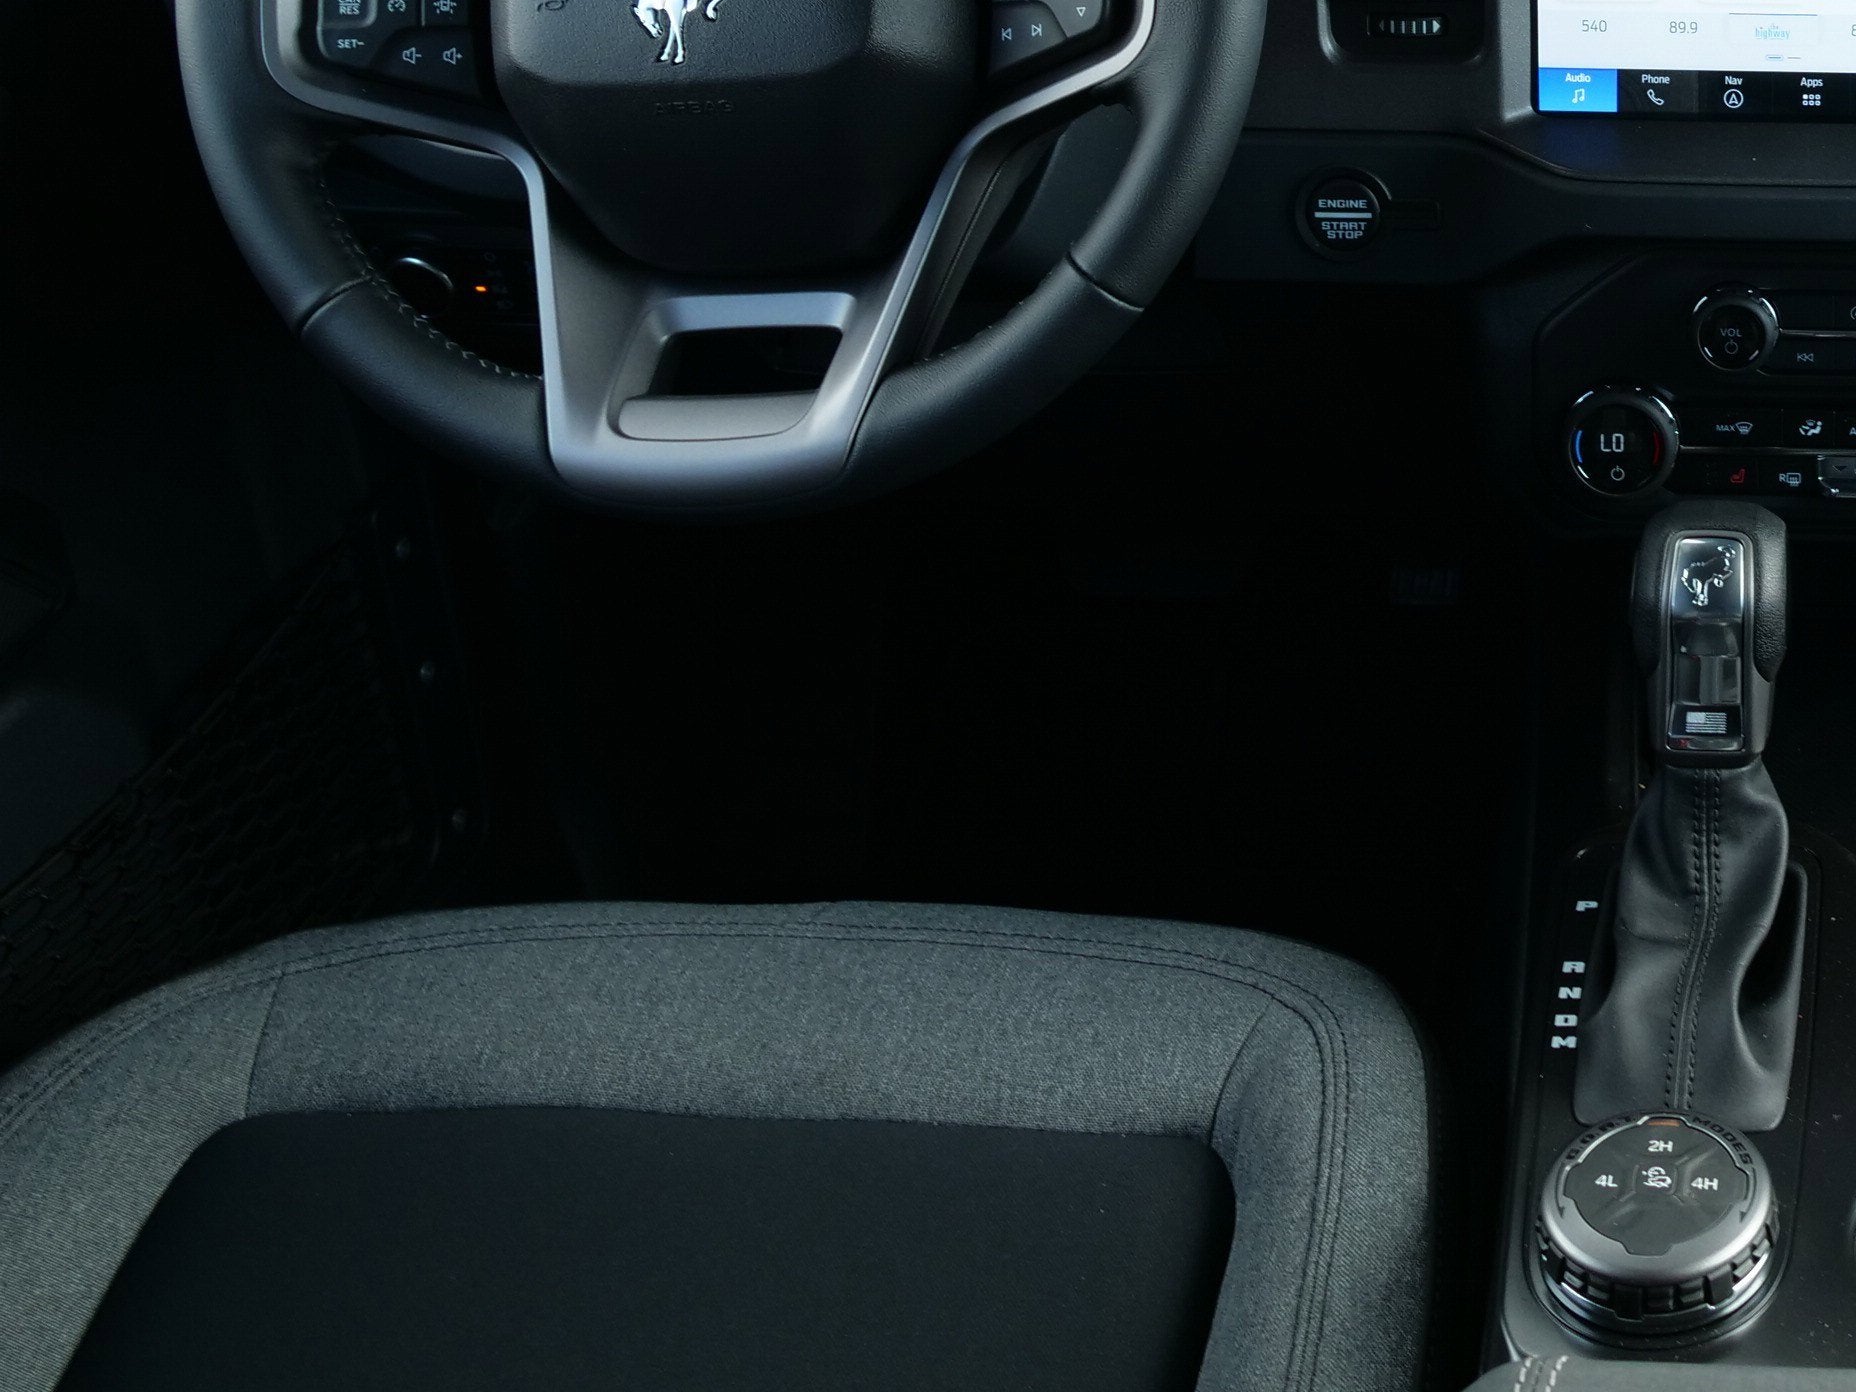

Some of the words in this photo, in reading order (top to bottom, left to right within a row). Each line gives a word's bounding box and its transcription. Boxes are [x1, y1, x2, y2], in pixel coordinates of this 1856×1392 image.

[338, 5, 360, 16] RES
[1581, 19, 1608, 33] 540
[1669, 21, 1698, 34] 89.9
[1565, 73, 1591, 83] Audio
[1641, 74, 1670, 84] Phone
[1725, 76, 1743, 86] Nav
[1800, 77, 1823, 89] Apps
[1318, 199, 1368, 209] ENGINE
[1321, 221, 1368, 231] START
[1327, 230, 1364, 240] STOP
[1720, 327, 1742, 337] VOL
[1716, 424, 1736, 432] MAX
[1600, 433, 1625, 453] LO
[1576, 901, 1598, 912] P
[1562, 961, 1585, 974] R
[1558, 987, 1582, 999] N
[1554, 1014, 1578, 1027] D
[1551, 1036, 1577, 1049] M
[1648, 1140, 1674, 1153] 2H
[1694, 1116, 1753, 1165] MODES
[1595, 1175, 1618, 1188] 4L
[1691, 1177, 1719, 1191] 4H
